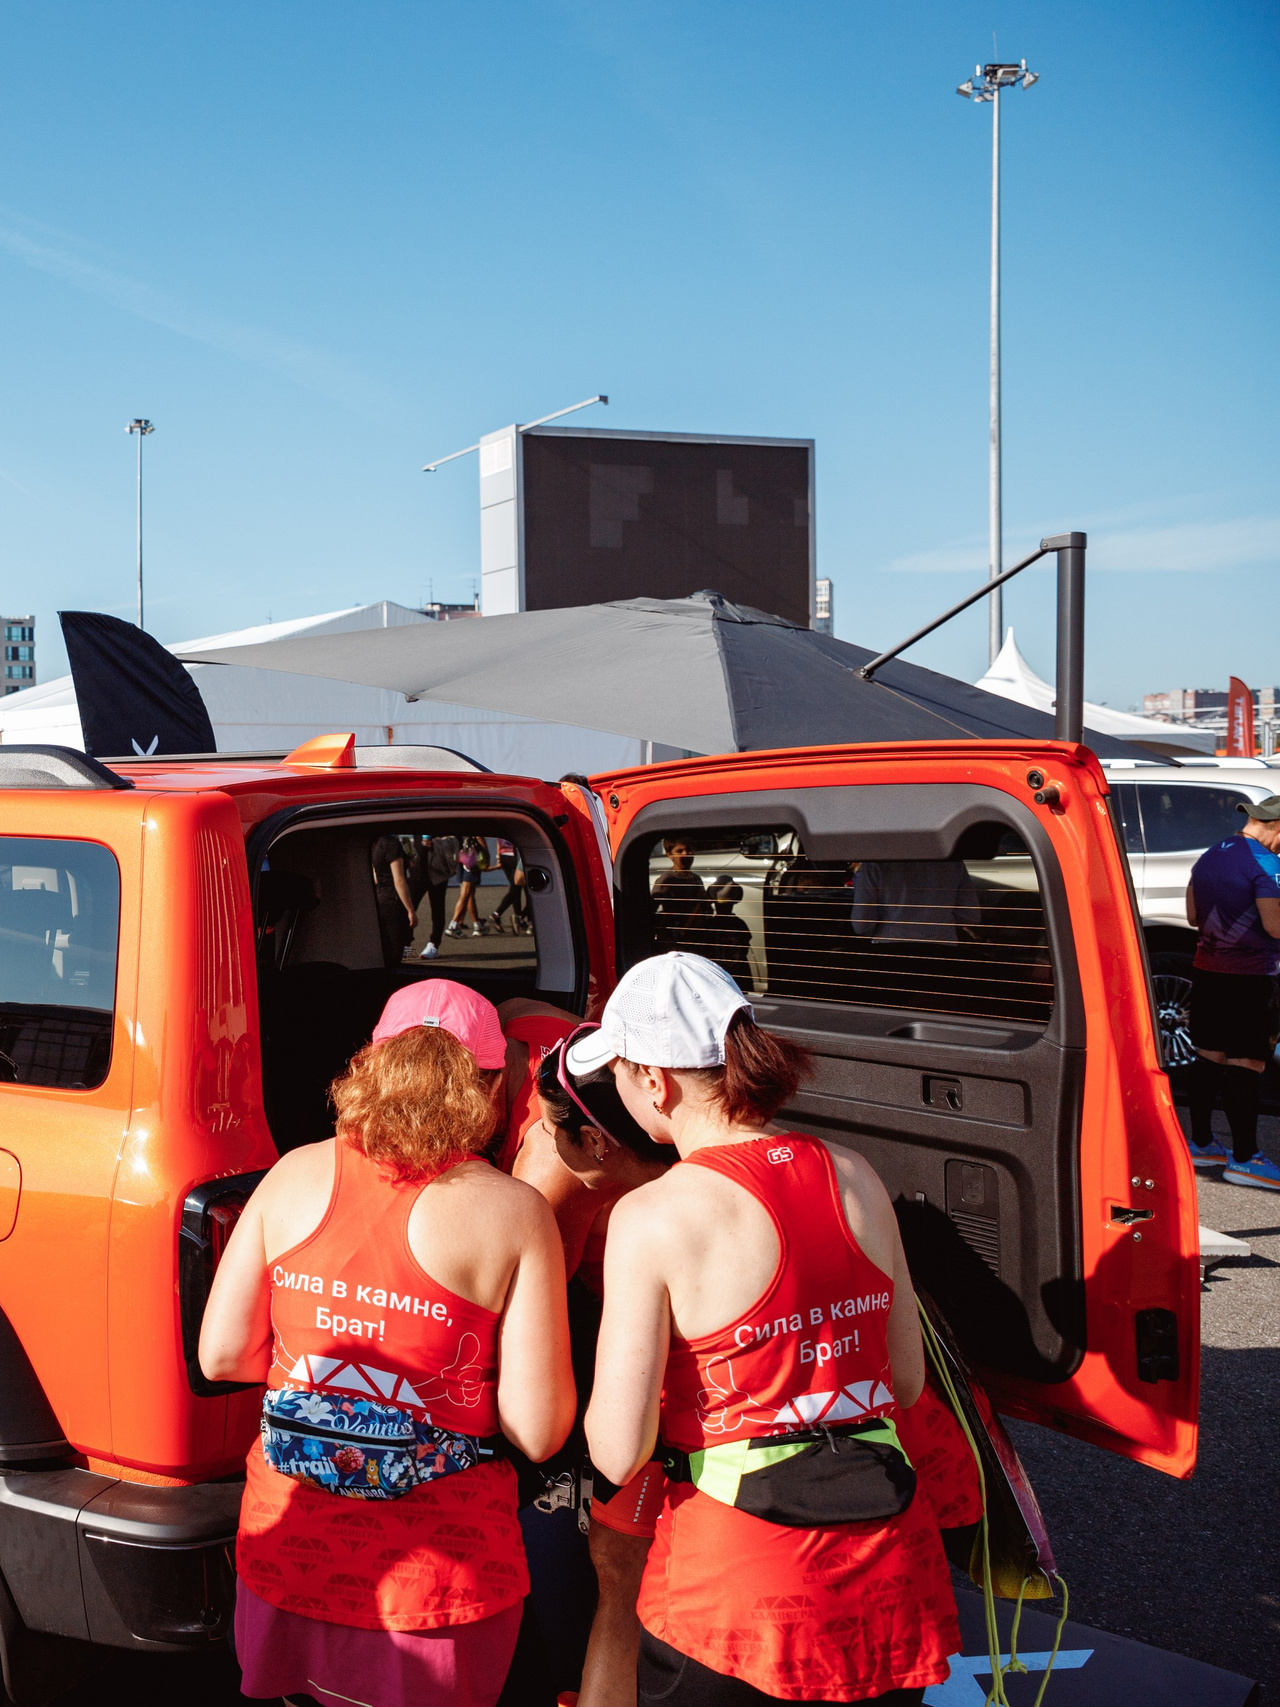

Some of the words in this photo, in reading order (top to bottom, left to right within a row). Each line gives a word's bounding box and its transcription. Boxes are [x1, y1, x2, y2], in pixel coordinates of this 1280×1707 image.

[767, 1147, 794, 1165] GS
[273, 1265, 324, 1295] Сила
[331, 1280, 348, 1298] в
[356, 1284, 453, 1328] камне,
[315, 1306, 386, 1342] Брат!
[734, 1313, 803, 1348] Сила
[810, 1307, 824, 1326] в
[830, 1291, 890, 1321] камне,
[800, 1329, 860, 1368] Брат!
